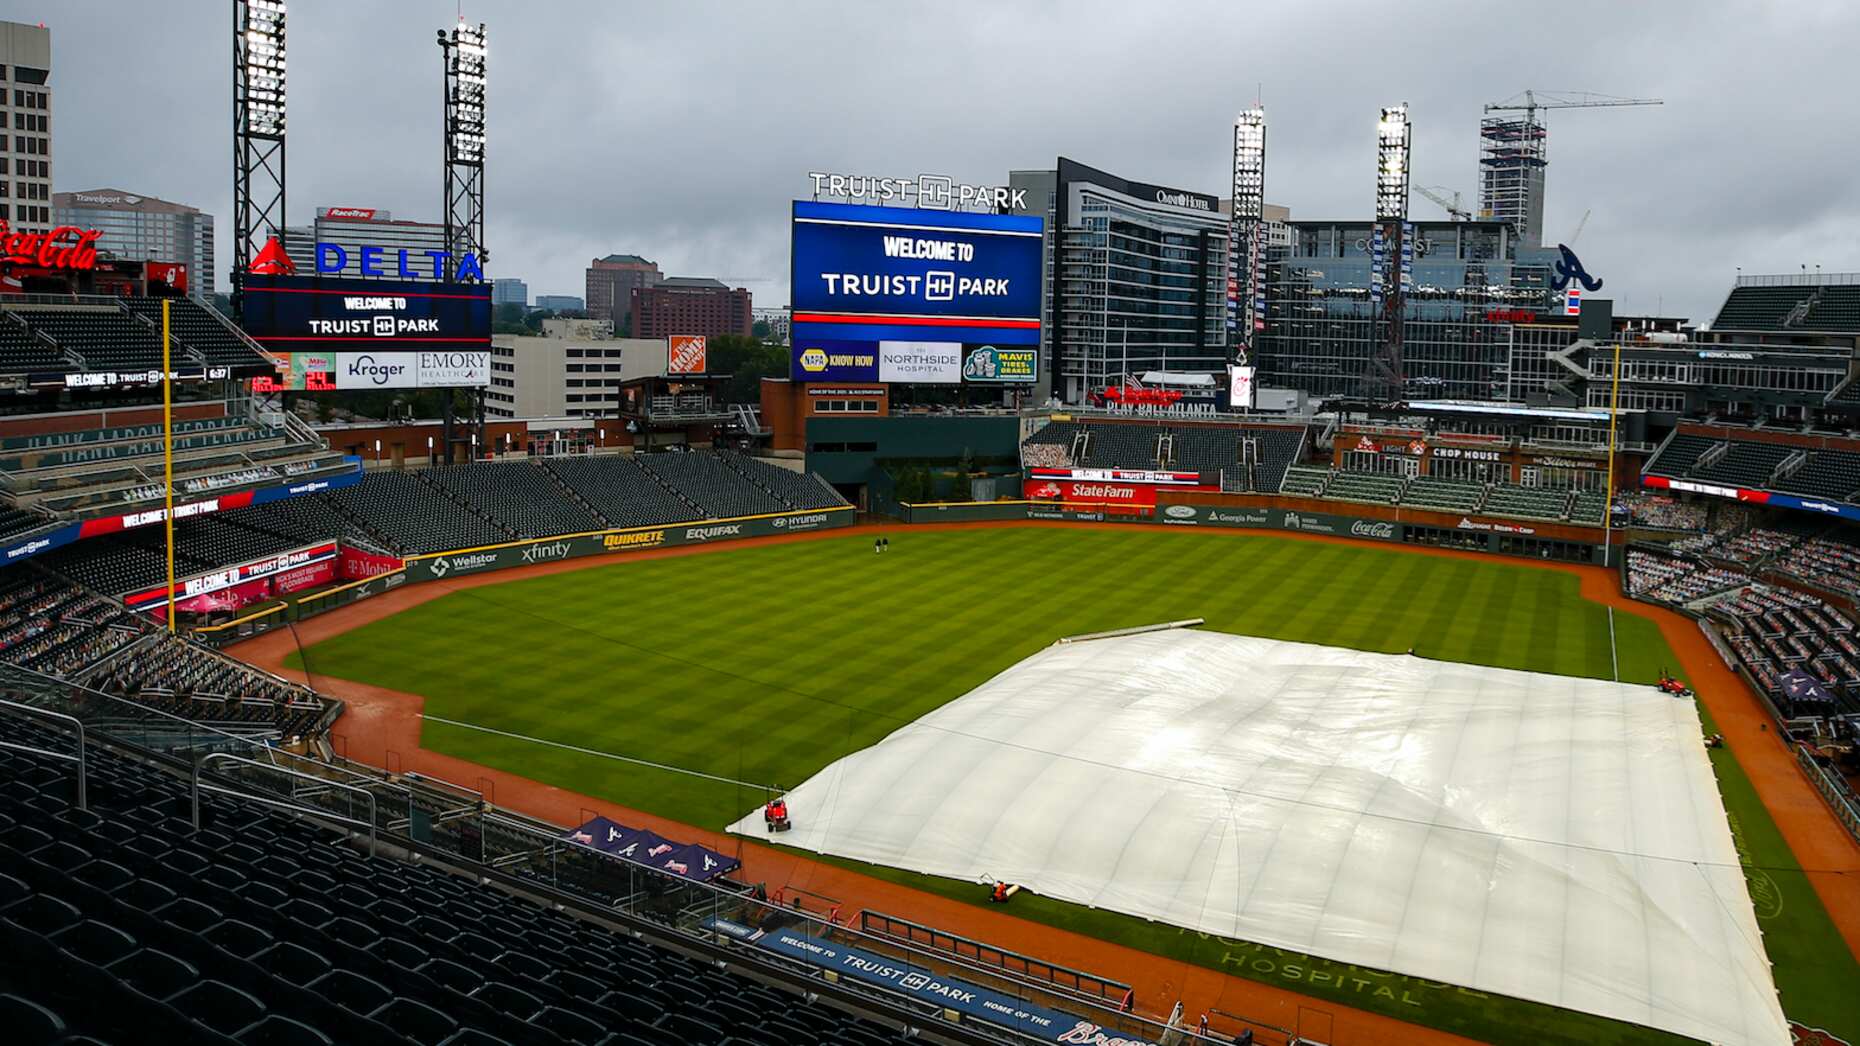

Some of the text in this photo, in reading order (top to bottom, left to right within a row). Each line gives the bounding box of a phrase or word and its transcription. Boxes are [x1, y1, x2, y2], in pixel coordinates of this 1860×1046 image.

[76, 193, 120, 205] Travelport
[809, 172, 1027, 210] TRUIST PARK
[884, 236, 973, 262] WELCOME TO
[316, 242, 484, 281] DELTA
[821, 274, 1009, 296] TRUIST PARK
[344, 297, 406, 310] WELCOME TO
[309, 318, 439, 334] TRUIST PARK
[421, 353, 487, 368] EMORY
[804, 355, 874, 367] NAPA KNOW HOW
[883, 354, 958, 365] NORTHSIDE
[998, 353, 1033, 361] MAVIS
[209, 369, 227, 379] 6:37
[349, 355, 405, 385] Kroger
[65, 371, 179, 387] WELCOME TO TRUIST PRK
[1107, 401, 1217, 418] PLAY BALL ATLANTA
[1433, 447, 1500, 461] CHOP HOUSE
[123, 510, 164, 527] WELCOME
[173, 502, 199, 517] TRUIST
[199, 499, 219, 513] PARK
[789, 514, 827, 525] HYUNDAI
[1219, 513, 1267, 523] Georgia Power
[604, 530, 665, 546] QUIKRETE
[686, 525, 742, 540] EQUIFAX
[452, 554, 497, 567] Wellstar
[522, 542, 571, 563] xfinity
[185, 552, 310, 595] WELCOME TO TRUIST PARK
[780, 935, 823, 953] WELCOME
[823, 949, 836, 958] TO
[842, 955, 905, 980] TRUIST
[926, 981, 977, 1004] PARK
[983, 1000, 1014, 1014] HOME
[1014, 1010, 1030, 1019] OF
[1030, 1014, 1051, 1027] THE
[1222, 951, 1422, 1006] HOSPITAL
